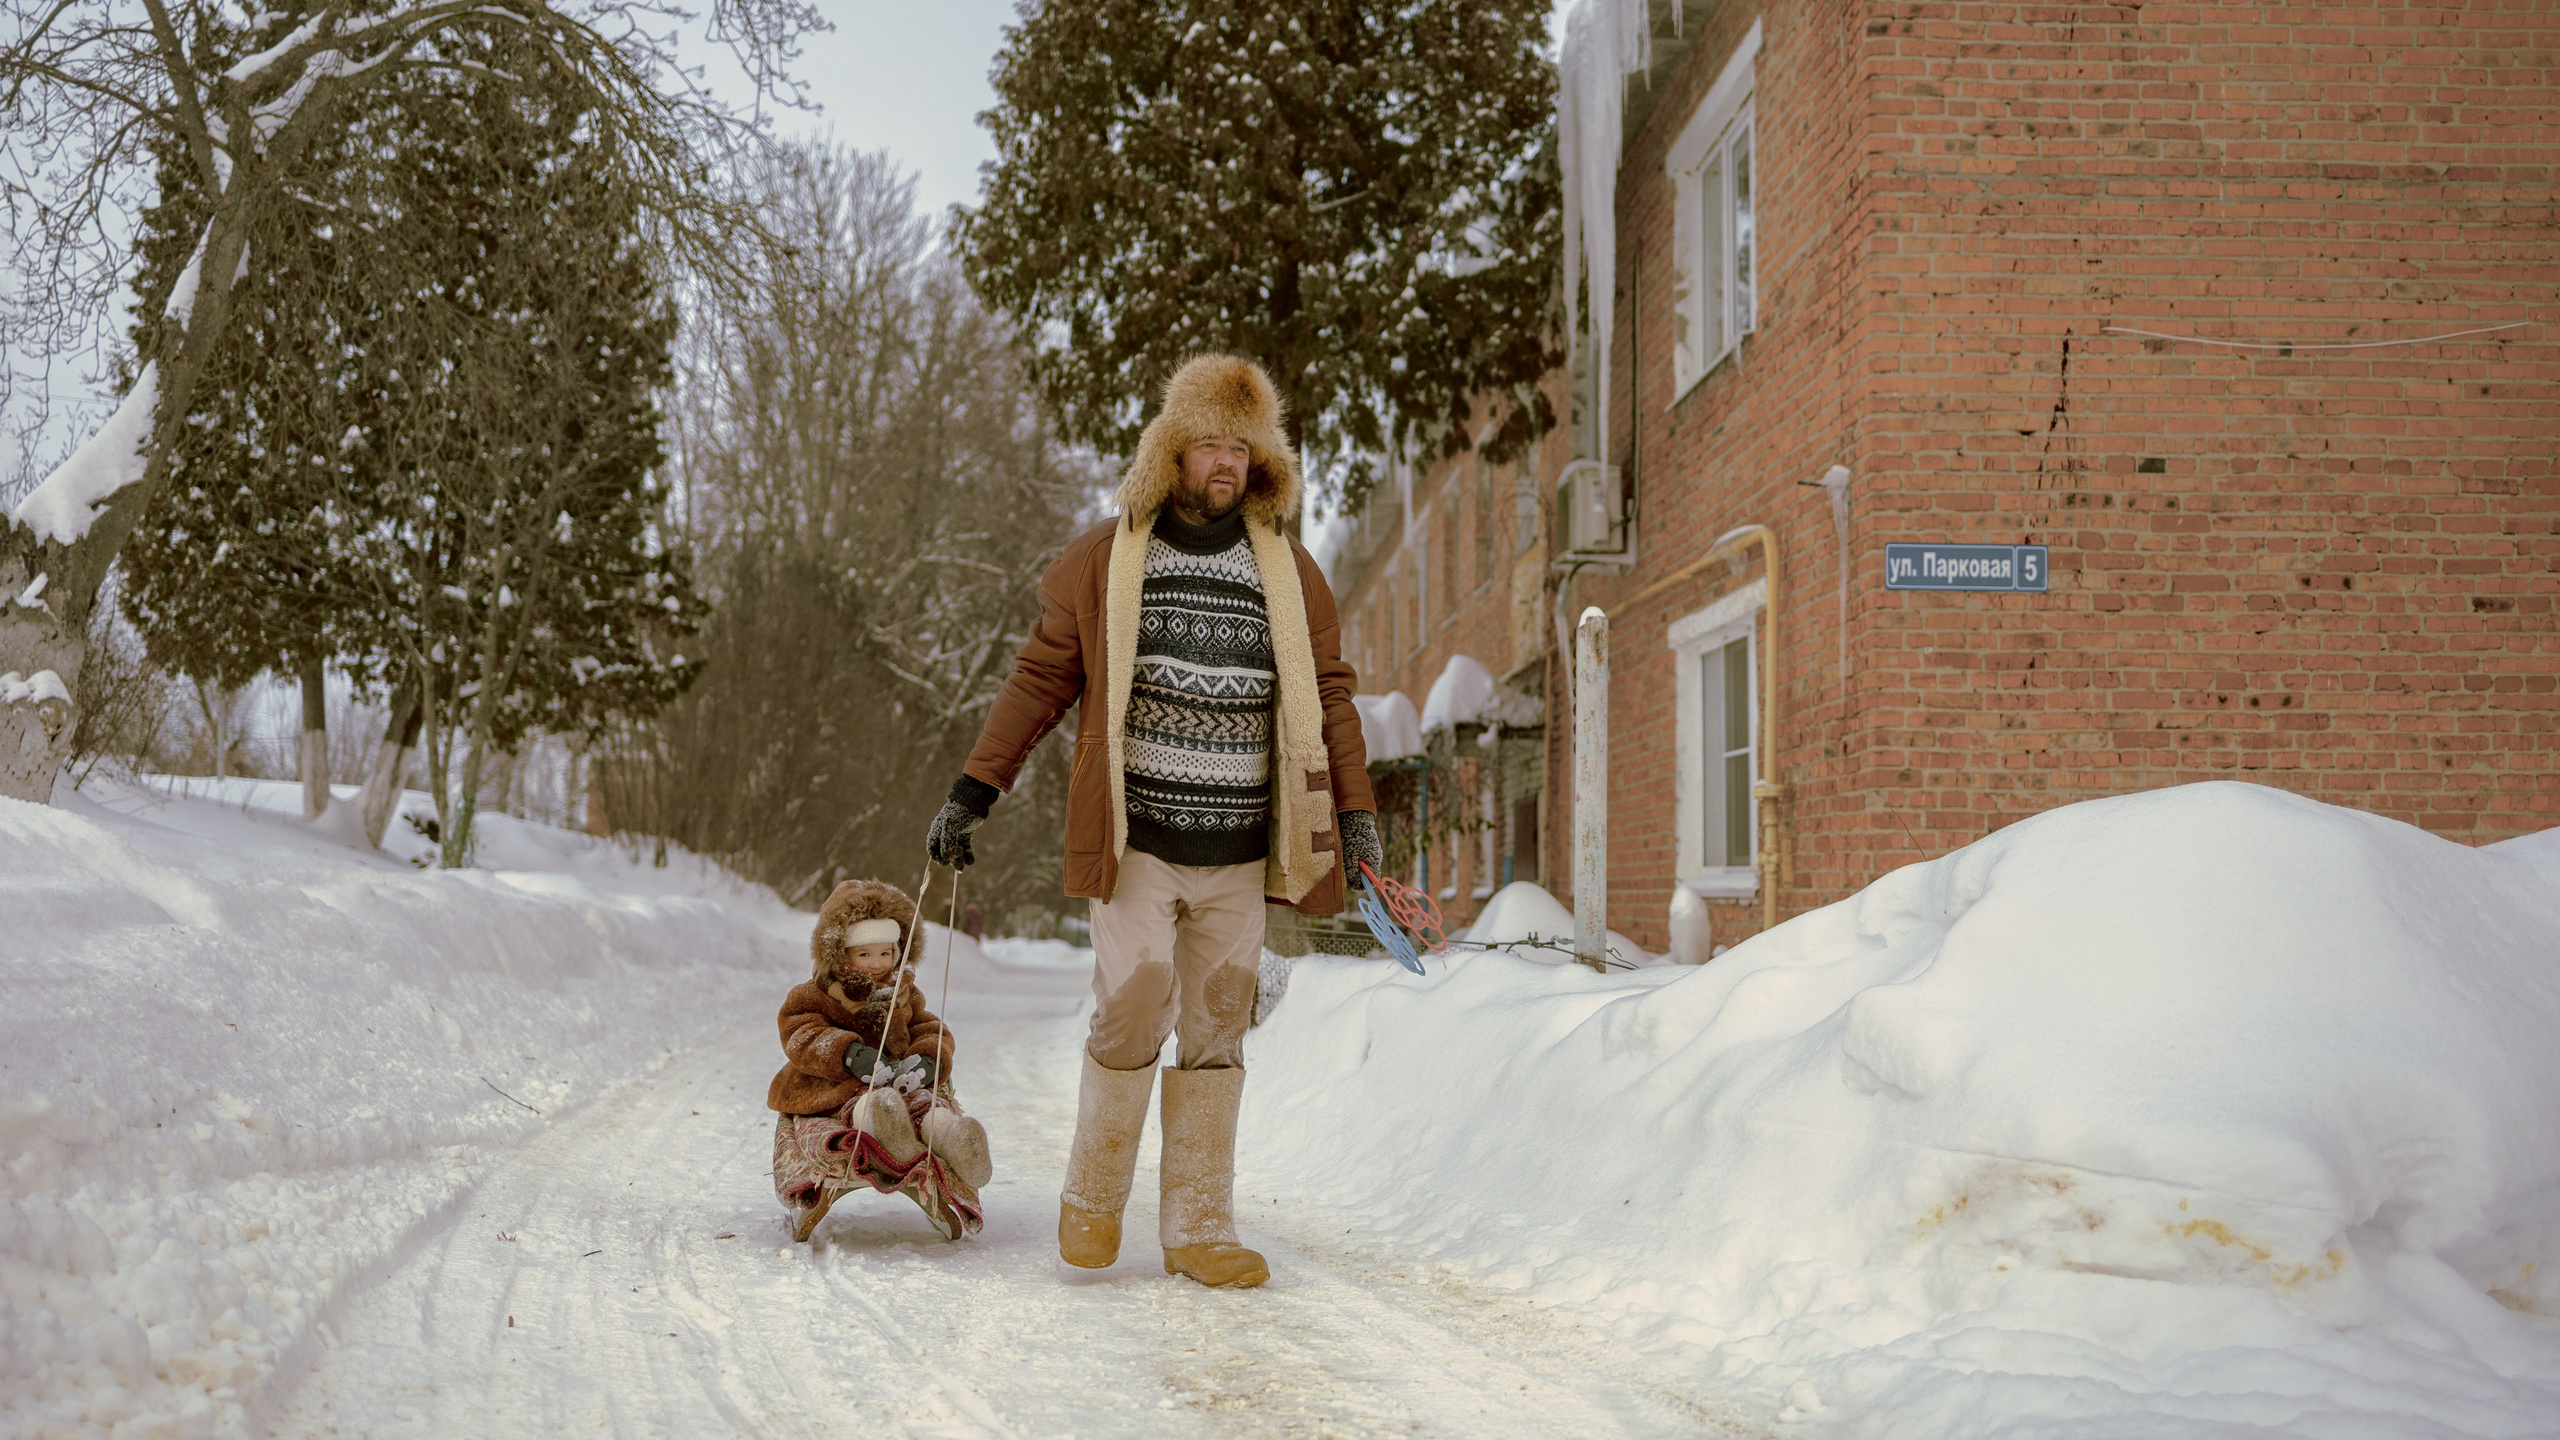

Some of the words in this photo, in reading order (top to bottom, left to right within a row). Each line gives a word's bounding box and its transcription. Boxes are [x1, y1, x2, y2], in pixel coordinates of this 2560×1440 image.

[1889, 557, 1917, 584] ул.
[1923, 551, 2011, 584] Парковая
[2024, 554, 2038, 582] 5
